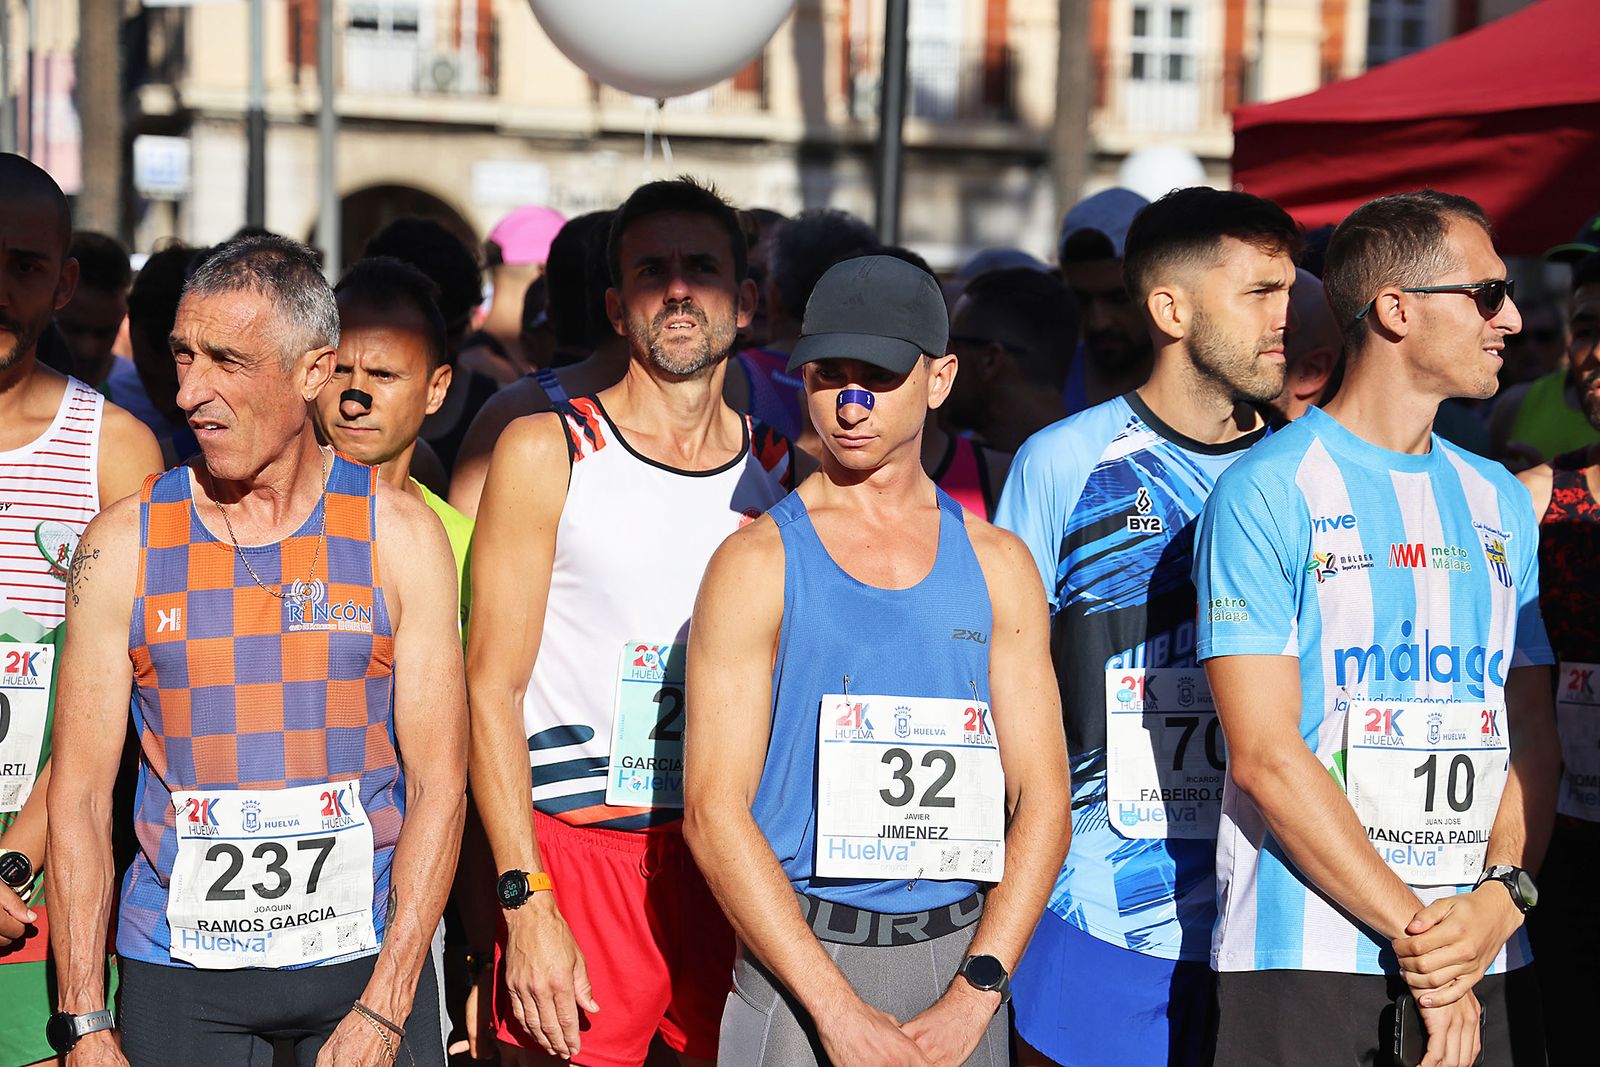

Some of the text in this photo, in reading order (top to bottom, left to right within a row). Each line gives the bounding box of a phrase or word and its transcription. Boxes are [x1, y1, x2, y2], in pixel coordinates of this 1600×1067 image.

[1128, 518, 1161, 531] BY2
[1432, 546, 1467, 558] metro
[1432, 557, 1471, 572] Málaga
[952, 629, 987, 644] 2XU
[5, 651, 40, 676] 21K
[3, 676, 38, 685] HUELVA
[632, 669, 668, 680] HUELVA
[836, 703, 874, 730] 21K
[964, 707, 991, 736] 21K
[1364, 708, 1404, 737] 21K
[1481, 709, 1500, 737] 21K
[835, 728, 874, 740] HUELVA
[913, 727, 947, 736] HUELVA
[964, 734, 993, 744] HUELVA
[1364, 735, 1404, 746] HUELVA
[1481, 736, 1502, 746] HUELVA
[622, 756, 684, 771] GARCIA
[879, 748, 956, 808] 32
[1414, 754, 1475, 812] 10
[1141, 789, 1210, 801] FABEIRO
[320, 789, 350, 817] 21K
[188, 798, 220, 826] 21K
[904, 812, 930, 820] JAVIER
[189, 825, 219, 836] HUELVA
[265, 819, 300, 829] HUELVA
[322, 817, 355, 829] HUELVA
[878, 825, 949, 840] JIMENEZ
[1363, 826, 1444, 844] MANCERA
[828, 839, 908, 861] Huelva
[1376, 845, 1436, 866] uelva
[205, 836, 336, 901] 237
[254, 904, 291, 913] JOAQUIN
[197, 906, 336, 932] RAMOS GARCIA
[182, 930, 265, 952] Huelva
